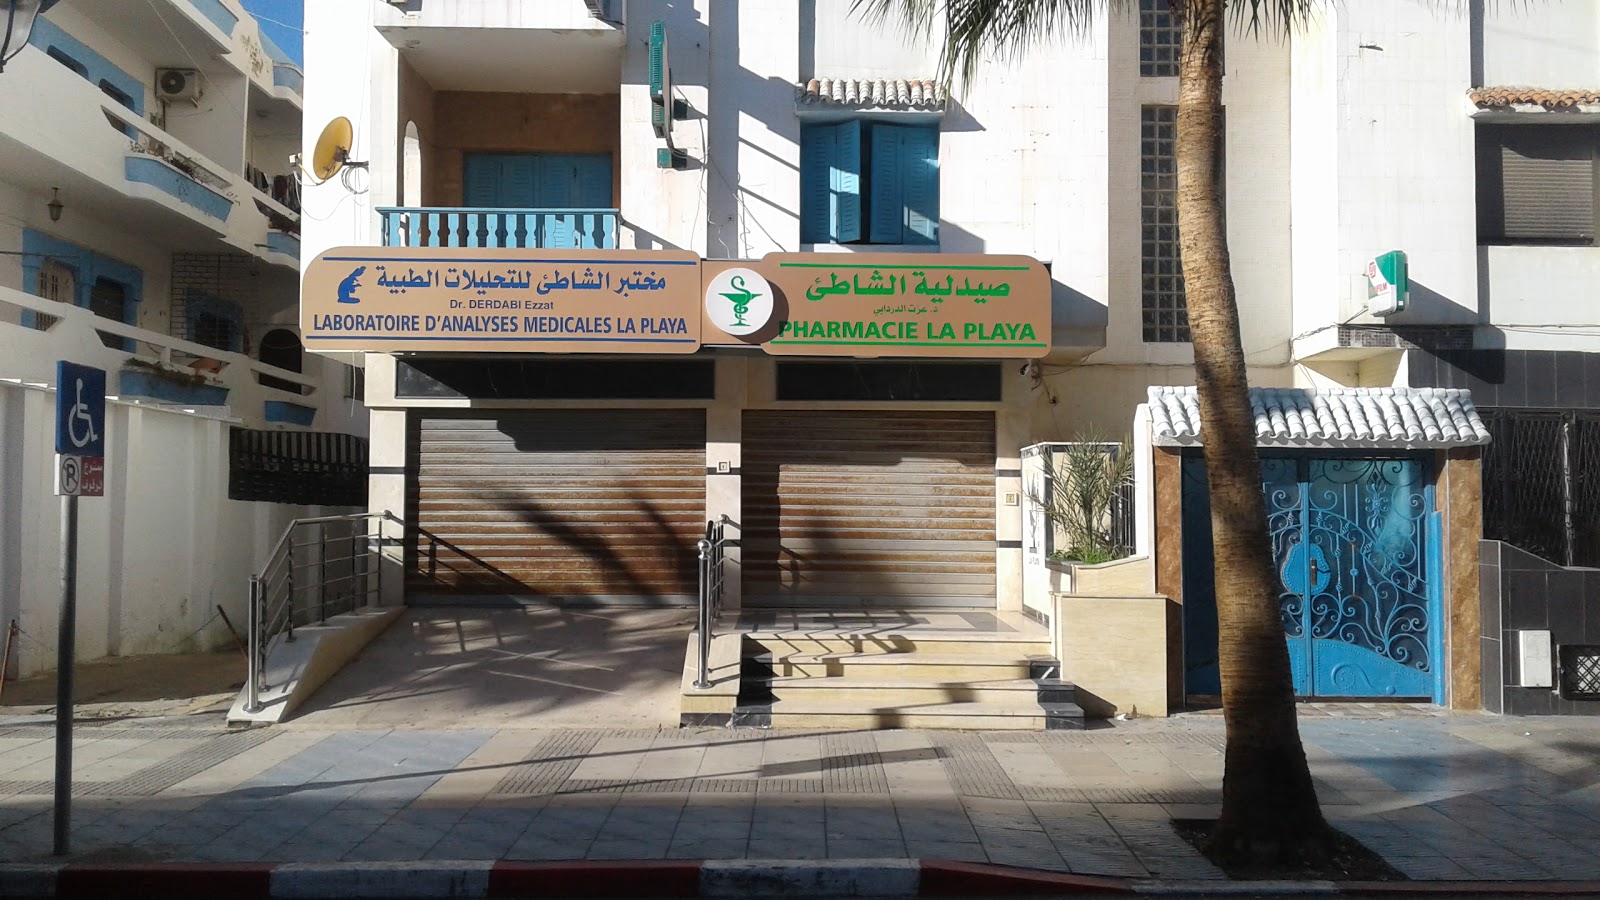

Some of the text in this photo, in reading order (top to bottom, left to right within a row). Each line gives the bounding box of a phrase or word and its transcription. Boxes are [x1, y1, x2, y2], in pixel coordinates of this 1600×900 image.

[375, 265, 666, 297] مختبر الشاطئ للتحليلات الطبية
[805, 269, 1011, 304] صيدلية الشاطئ
[449, 300, 554, 310] Dr. DERDABI Ezzat
[313, 314, 688, 335] LABORATOIRE D'ANALYSES MEDICALES LA PLAYA
[779, 320, 1036, 341] PHARMACIE LA PLAYA
